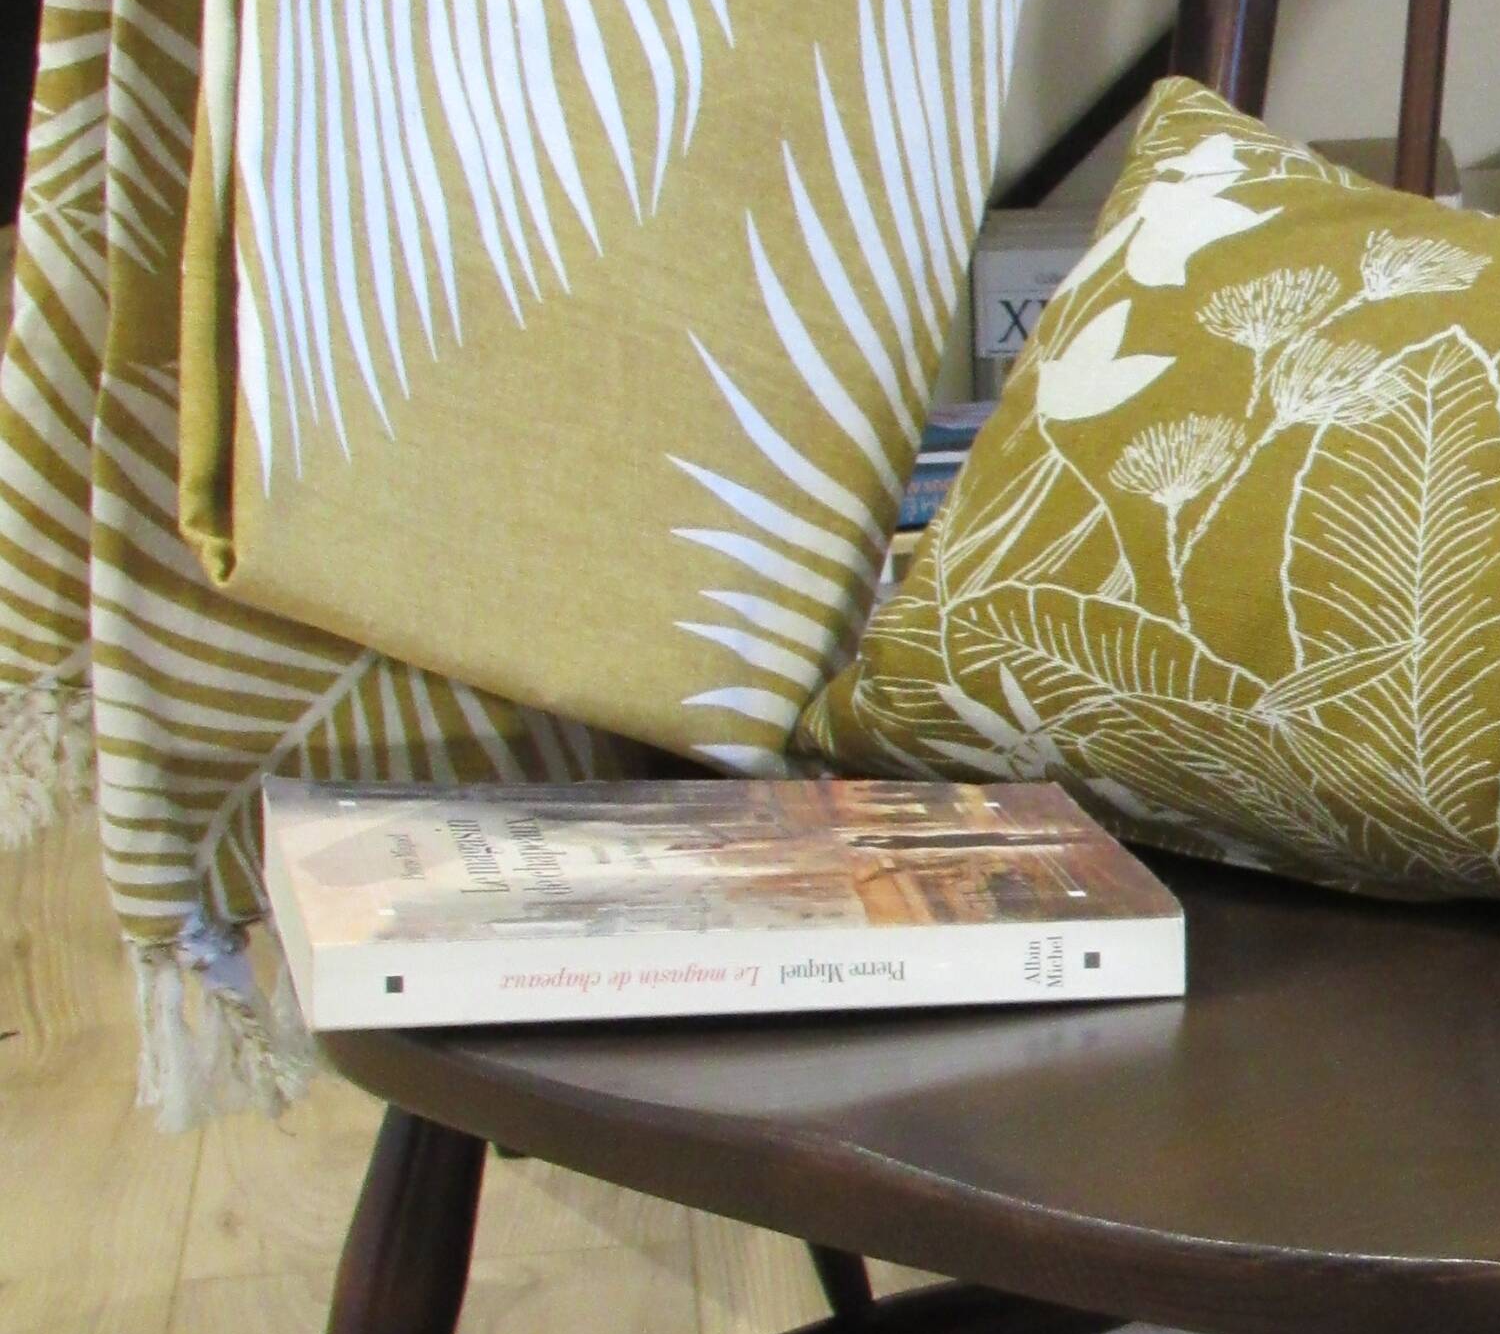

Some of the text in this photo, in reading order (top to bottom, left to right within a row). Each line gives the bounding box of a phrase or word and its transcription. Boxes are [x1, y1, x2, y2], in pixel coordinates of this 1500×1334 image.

[446, 819, 511, 893] Le magasin
[506, 815, 573, 895] de chapeaux
[499, 962, 761, 993] Le magasin de chapeaux
[780, 958, 905, 985] Pierre Miquel
[1024, 939, 1042, 984] Albin
[1046, 935, 1063, 989] Michel
